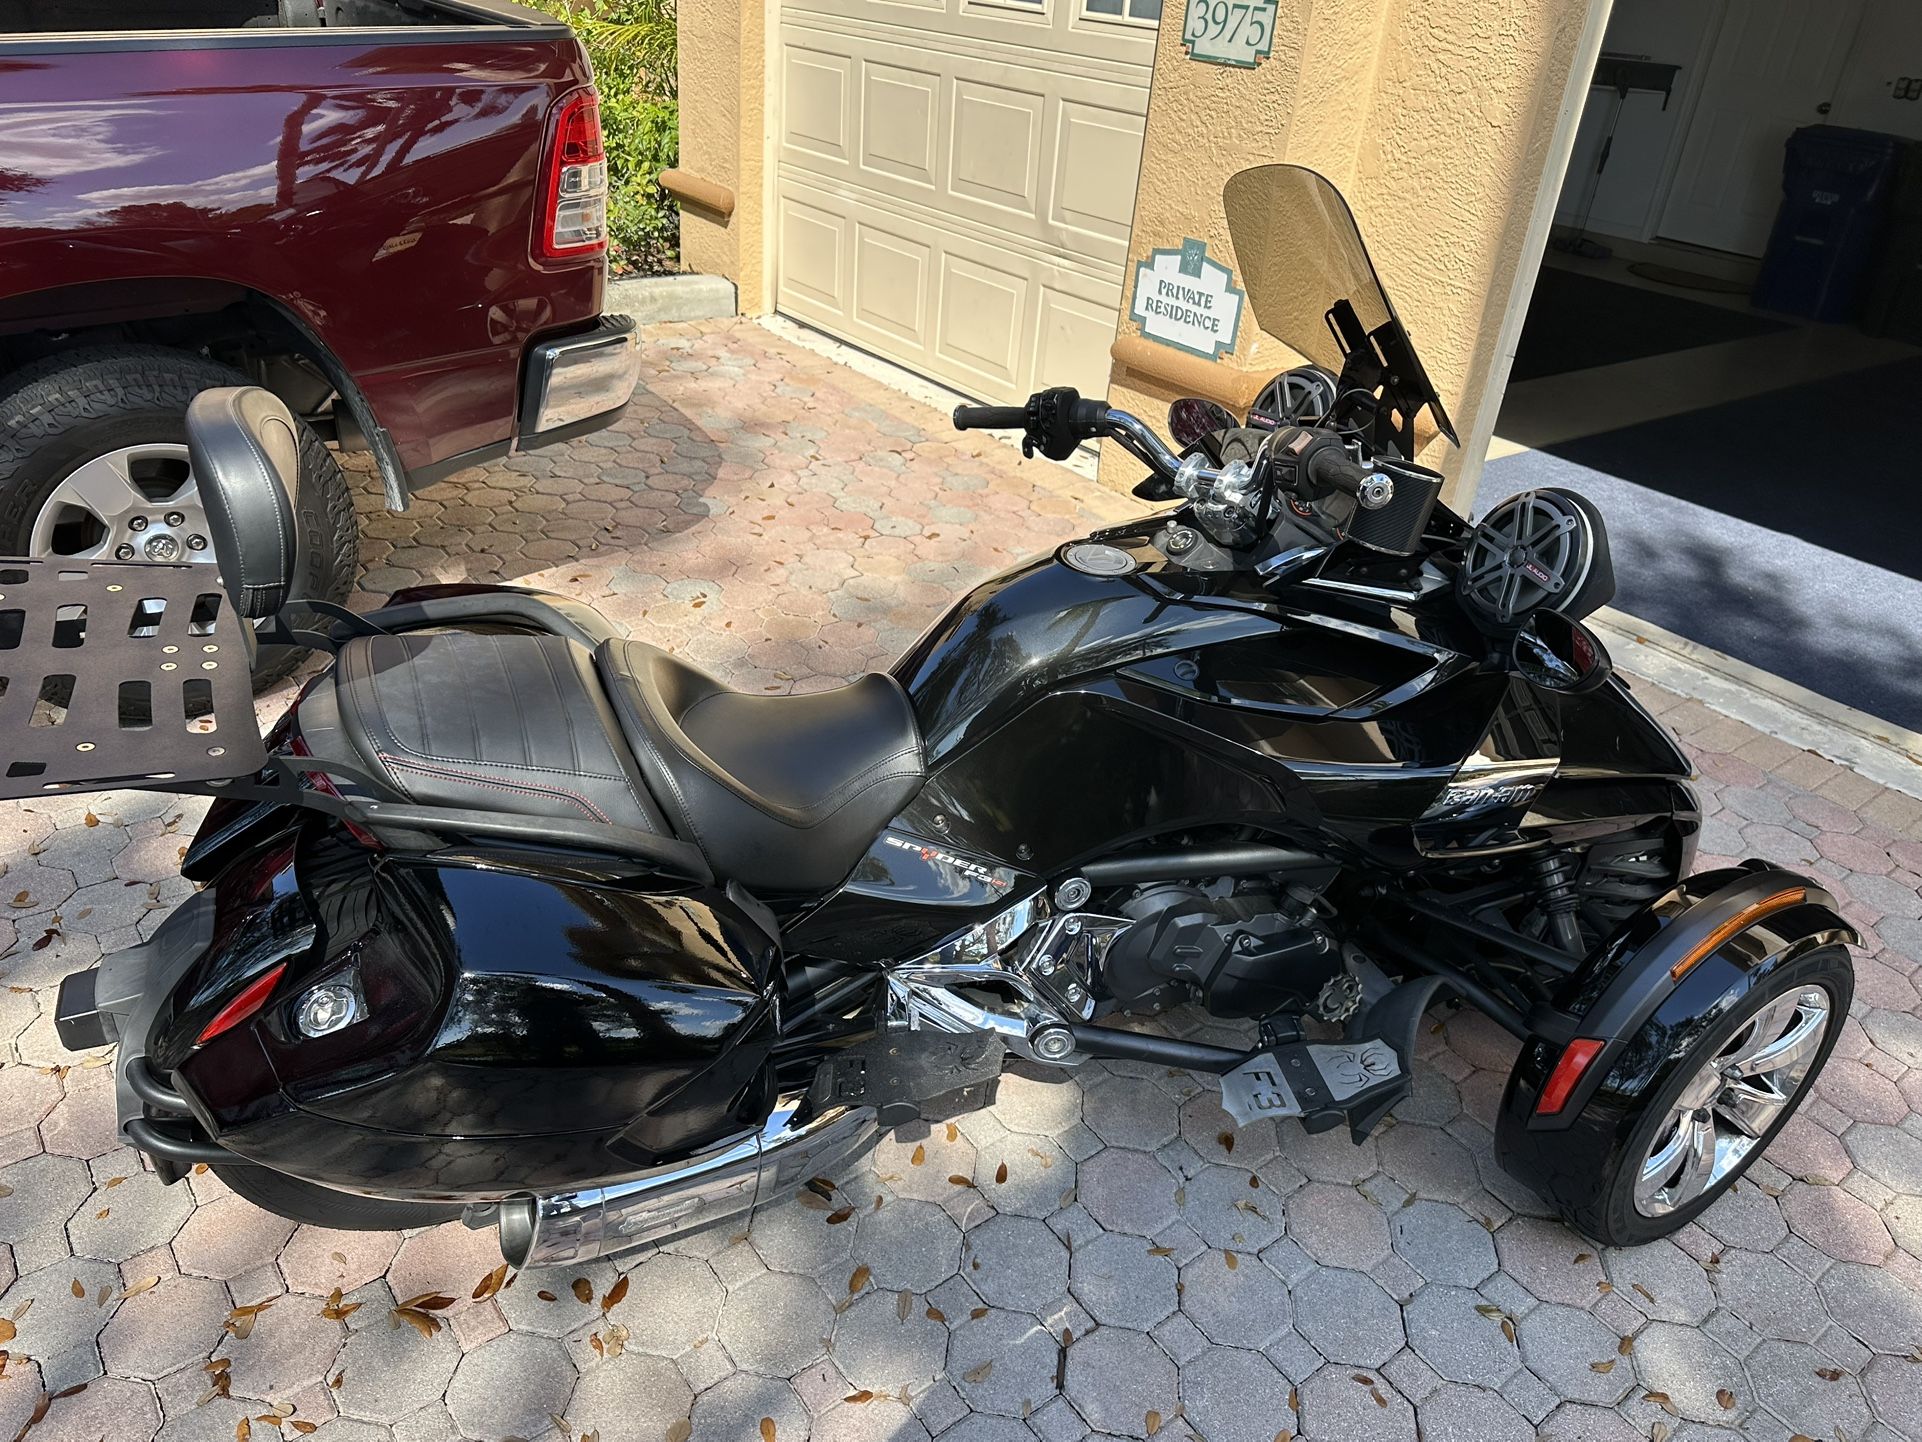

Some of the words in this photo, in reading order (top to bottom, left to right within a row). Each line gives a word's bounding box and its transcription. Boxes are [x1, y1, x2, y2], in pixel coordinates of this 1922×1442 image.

[1191, 0, 1267, 47] 3975
[1157, 279, 1214, 310] PRIVATE
[1144, 296, 1220, 333] RESIDENCE
[884, 836, 988, 875] SPYDER
[1242, 1070, 1287, 1111] F3
